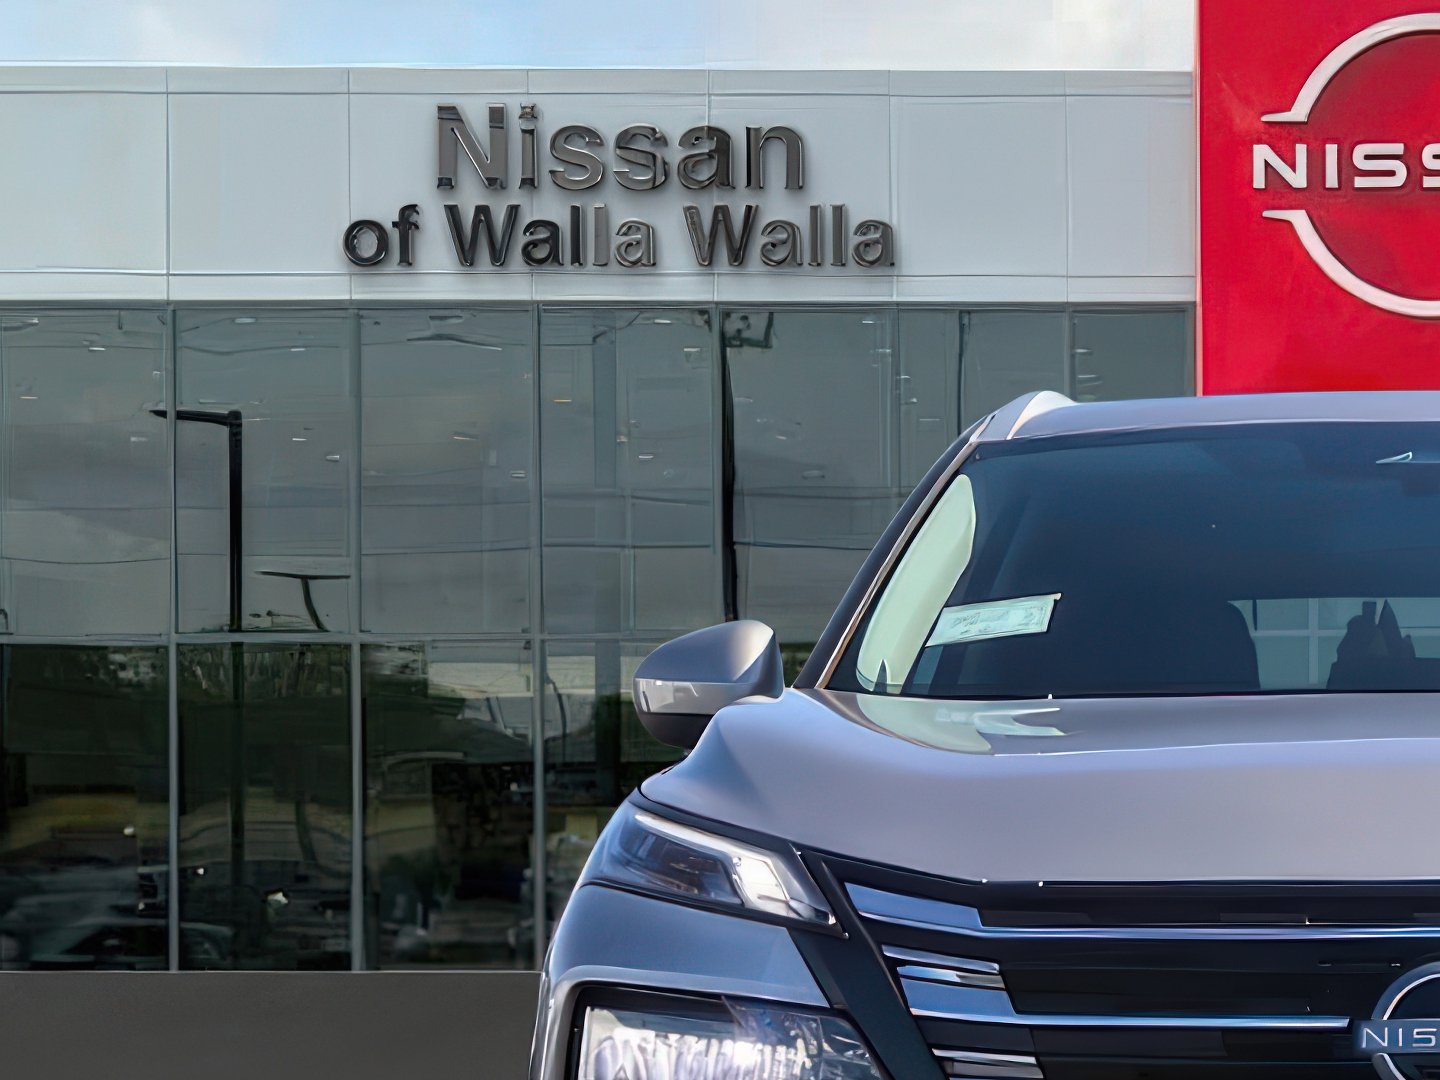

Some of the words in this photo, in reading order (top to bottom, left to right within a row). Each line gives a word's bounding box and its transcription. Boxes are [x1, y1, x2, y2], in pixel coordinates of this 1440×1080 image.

[436, 102, 804, 190] Nissan
[342, 203, 420, 267] of
[444, 203, 657, 267] Walla
[682, 203, 895, 267] Walla
